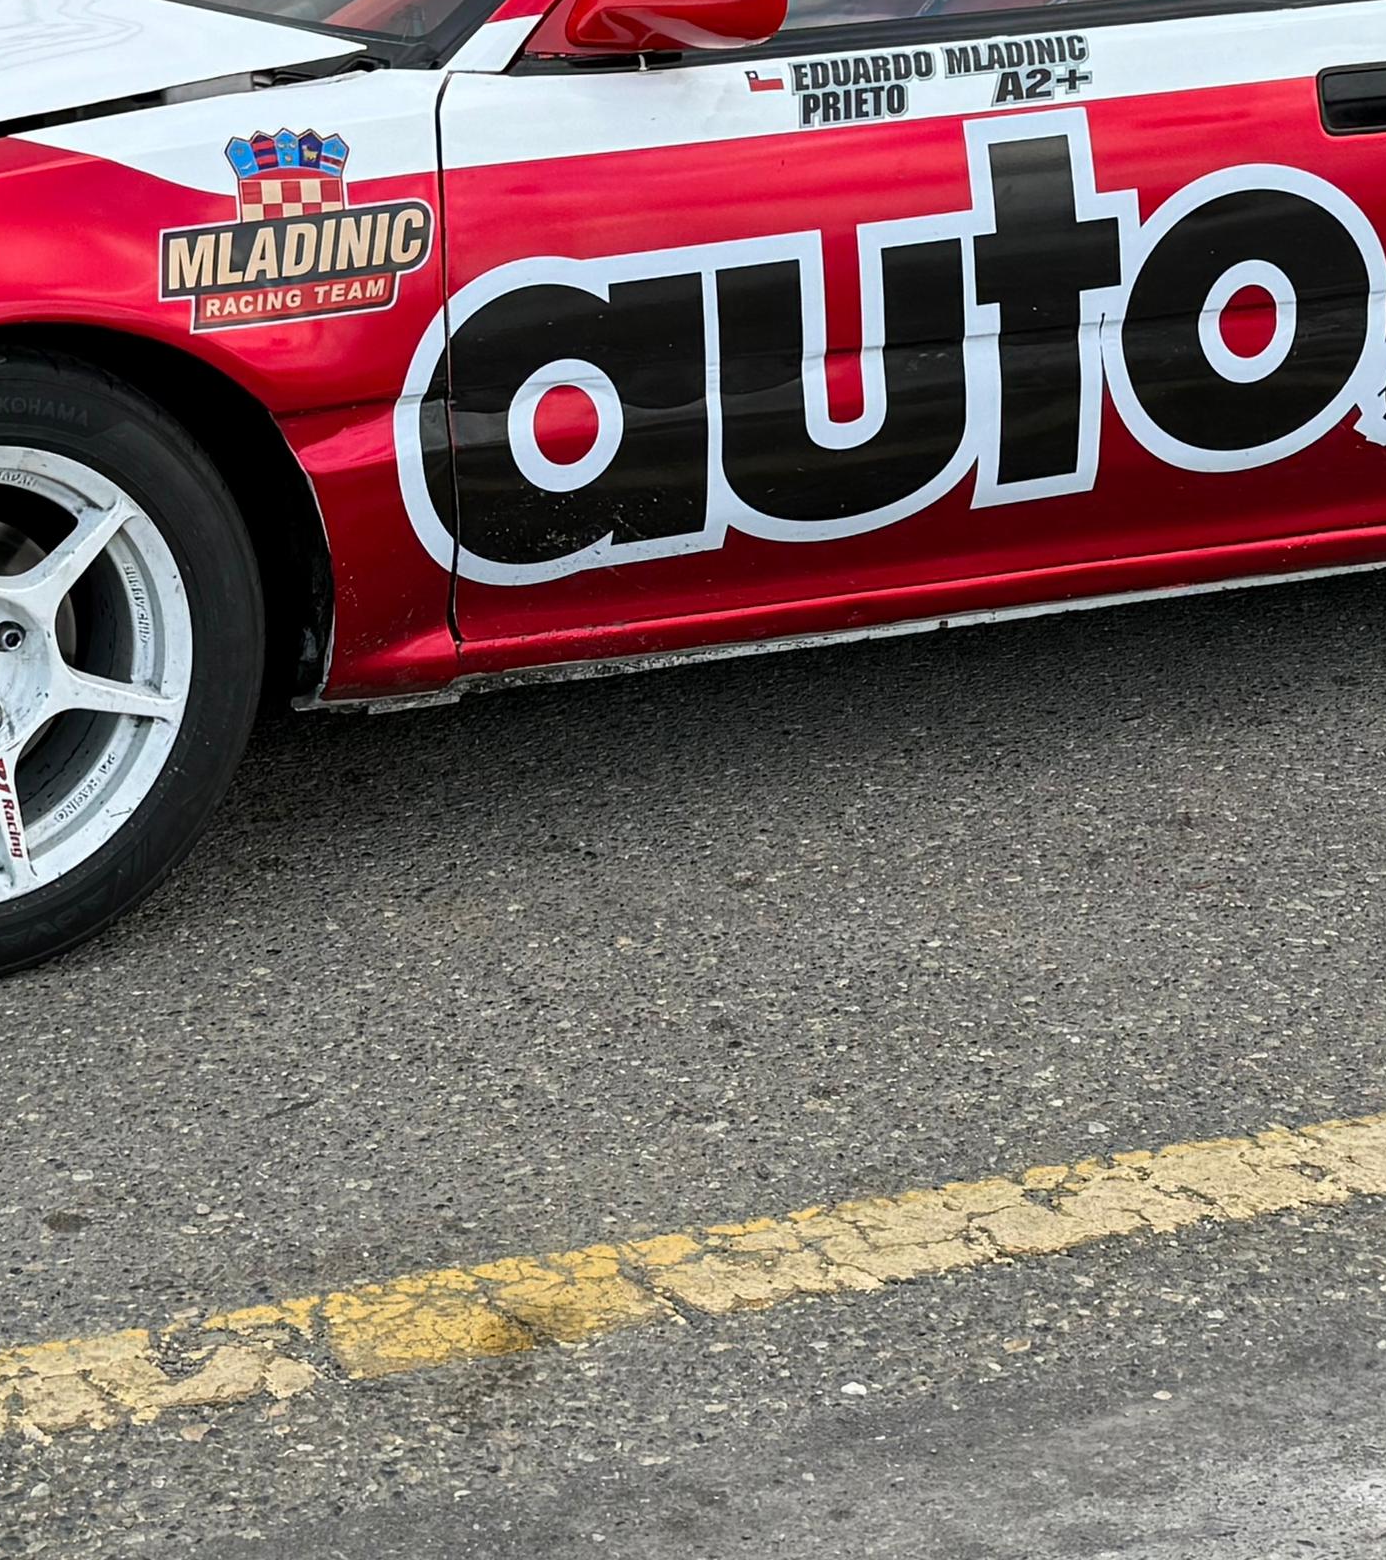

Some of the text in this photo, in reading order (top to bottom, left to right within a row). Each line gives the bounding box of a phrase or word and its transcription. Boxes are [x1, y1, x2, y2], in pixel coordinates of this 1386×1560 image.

[794, 35, 1088, 91] EDUARDO MLADINIC
[995, 67, 1091, 103] A2+
[802, 83, 906, 125] PRIETO
[168, 208, 424, 290] MLADINIC
[206, 278, 386, 318] RACING TEAM
[1, 798, 24, 858] Racing
